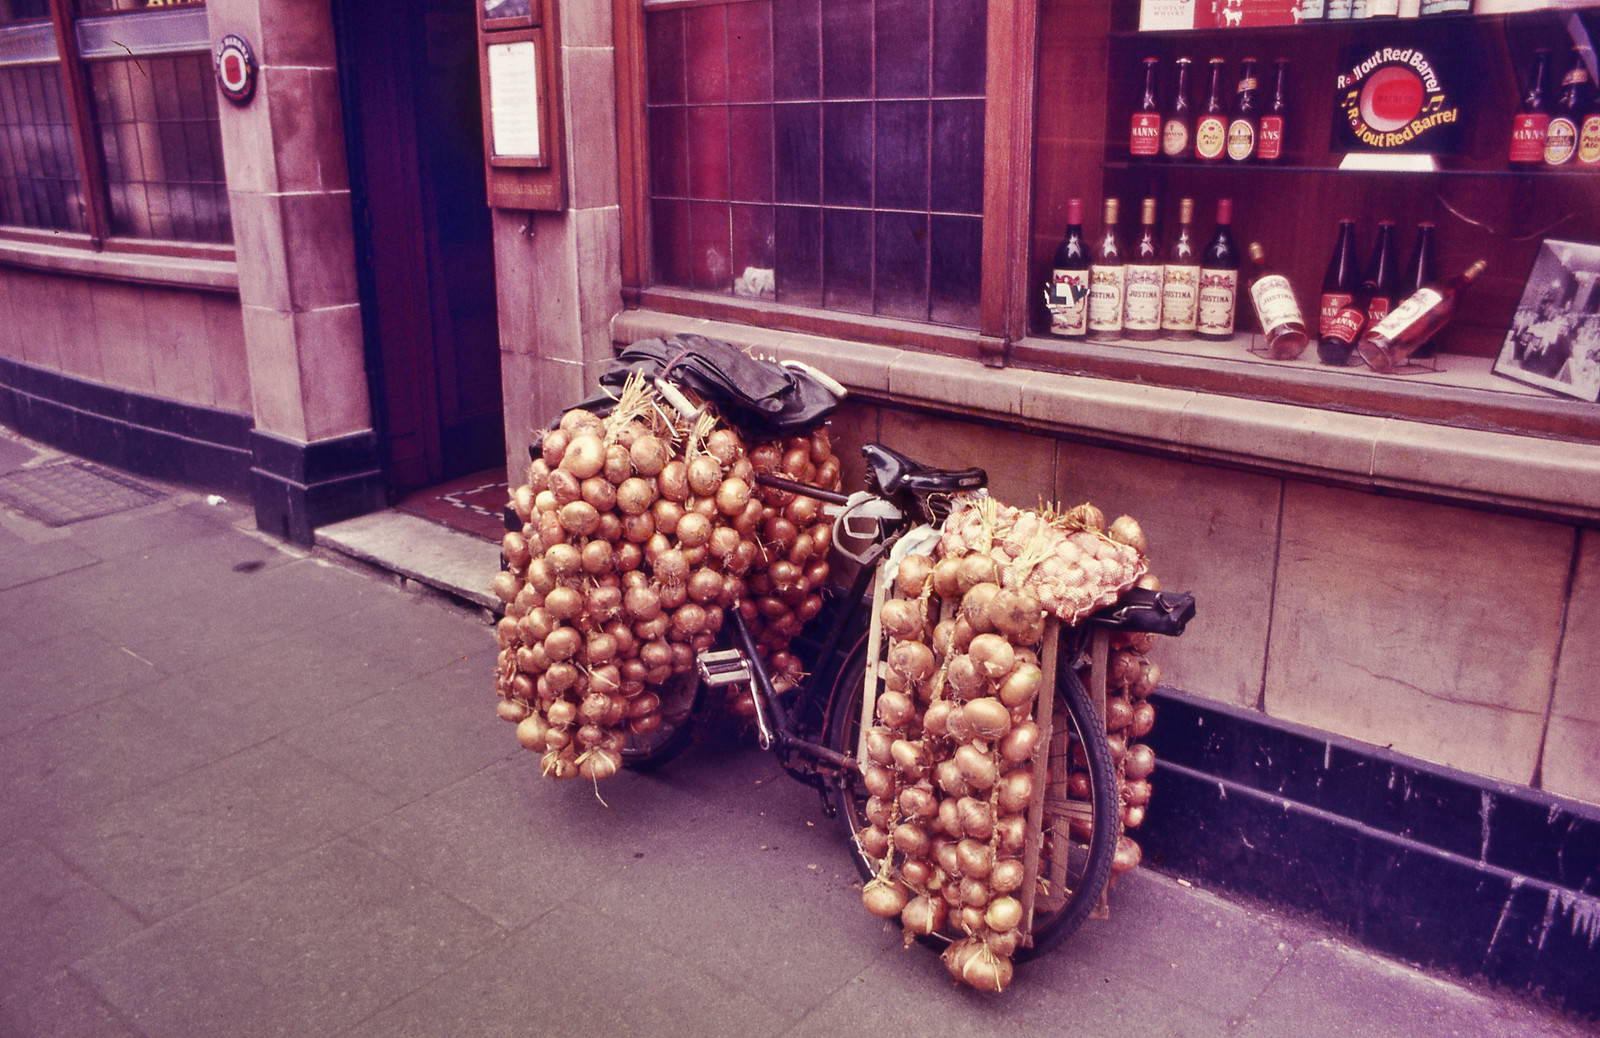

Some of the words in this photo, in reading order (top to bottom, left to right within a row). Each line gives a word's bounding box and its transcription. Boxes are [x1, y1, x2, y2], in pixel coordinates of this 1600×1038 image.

[1337, 65, 1363, 89] Roll
[1361, 51, 1383, 74] out
[1383, 47, 1413, 63] Red
[1409, 51, 1441, 93] Barrel
[1132, 127, 1159, 138] MANNS
[1347, 107, 1367, 137] Roll
[1362, 131, 1384, 147] out
[1385, 127, 1414, 147] Red
[1410, 108, 1458, 135] Barrel
[493, 183, 553, 195] RESTAURANT
[1128, 290, 1158, 298] JUSTINA
